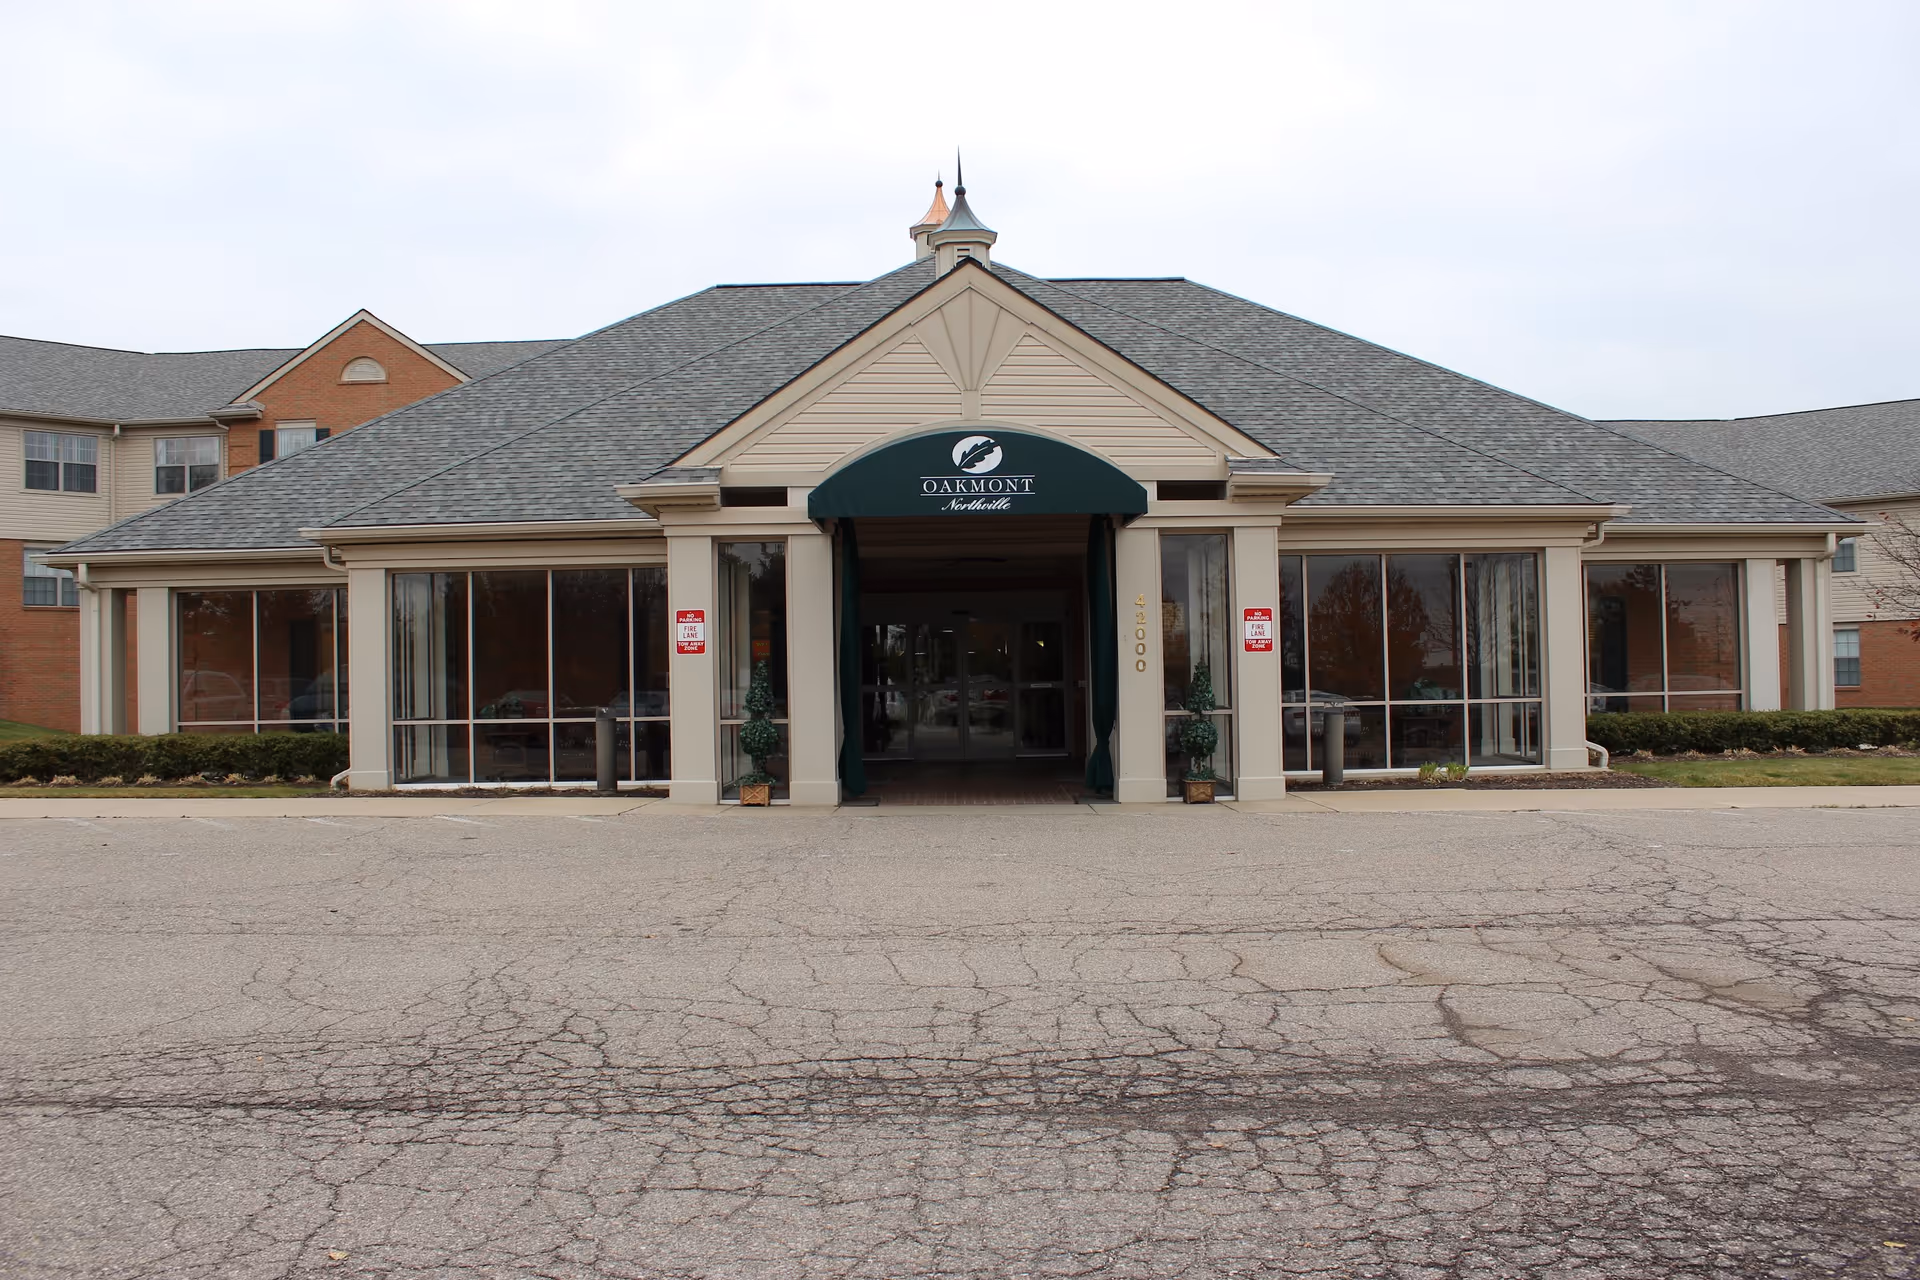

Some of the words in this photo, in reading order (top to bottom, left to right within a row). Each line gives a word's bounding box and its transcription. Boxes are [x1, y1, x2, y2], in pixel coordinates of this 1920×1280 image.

[923, 478, 1033, 493] OAKMONT
[941, 497, 1011, 511] Northville
[1135, 594, 1147, 672] 42000
